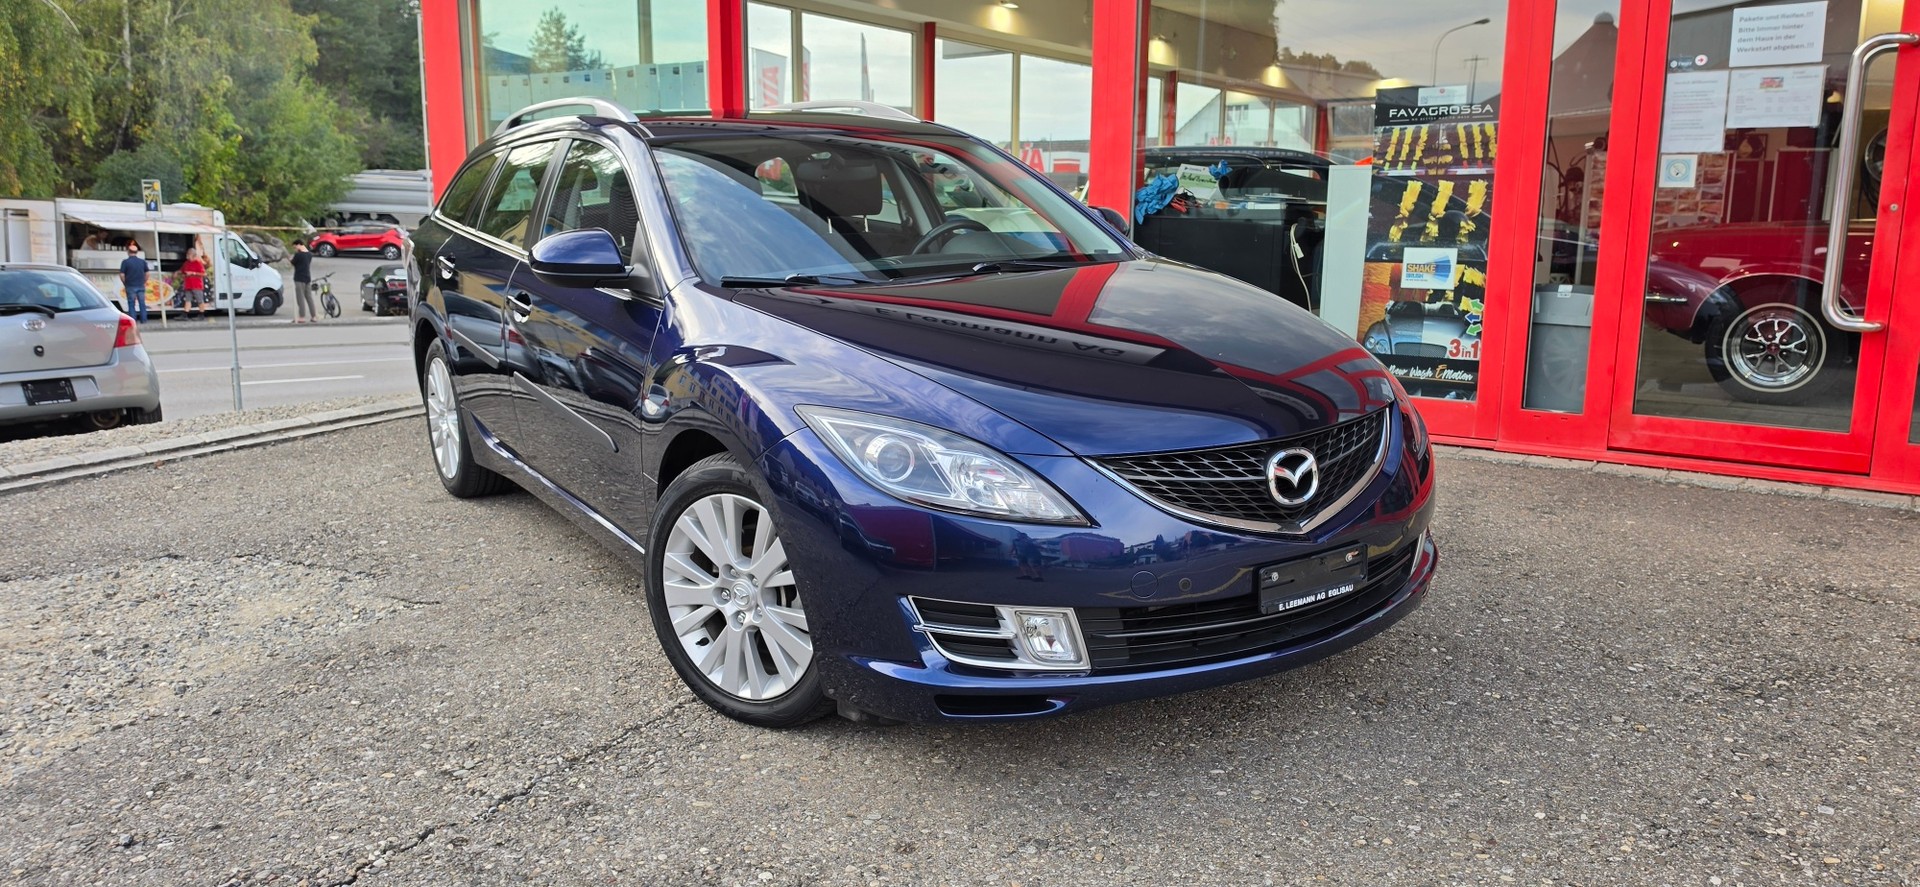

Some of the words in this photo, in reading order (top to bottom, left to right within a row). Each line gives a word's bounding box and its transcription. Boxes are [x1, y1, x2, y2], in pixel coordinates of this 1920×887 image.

[1738, 15, 1764, 23] Pakete
[1782, 23, 1804, 31] hinter
[1736, 45, 1772, 53] Werkstatt
[1389, 104, 1494, 118] FAVAGROSSA
[1407, 264, 1436, 273] SHAKE
[1389, 364, 1408, 375] New
[1409, 366, 1433, 379] Wash
[1278, 602, 1285, 611] E.
[1286, 595, 1316, 609] LEEMANN
[1316, 591, 1326, 601] AG
[1328, 584, 1354, 598] EGLISAU
